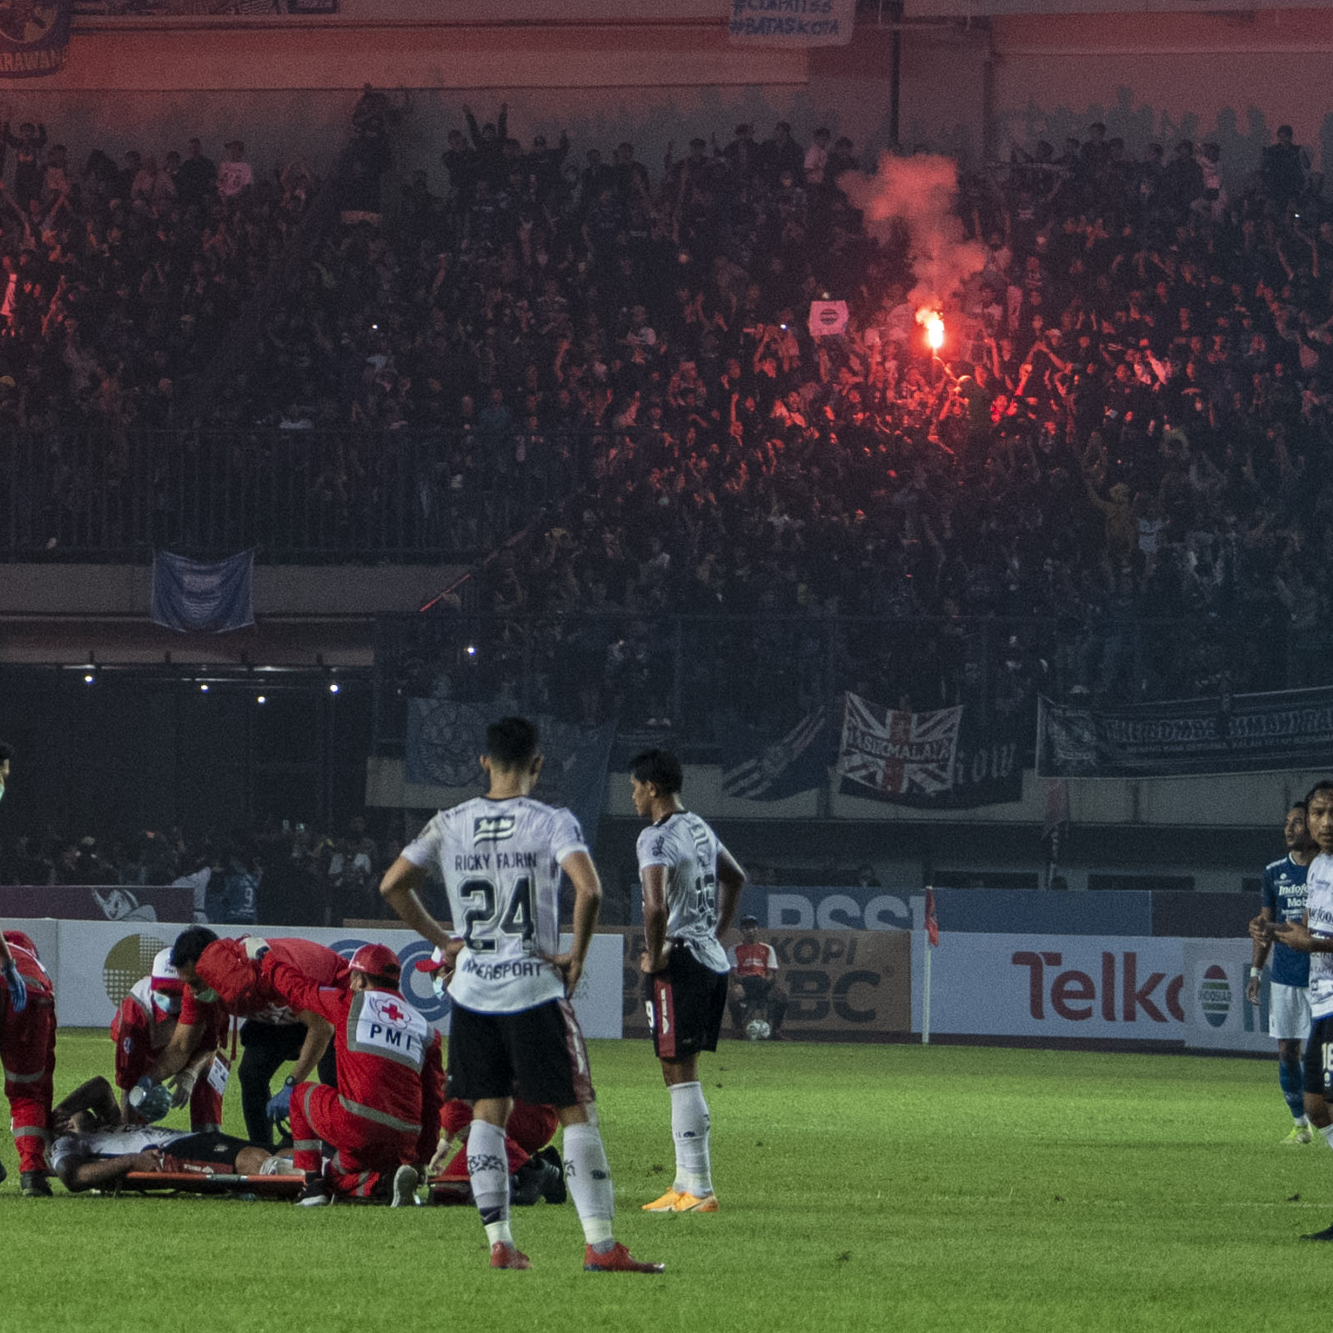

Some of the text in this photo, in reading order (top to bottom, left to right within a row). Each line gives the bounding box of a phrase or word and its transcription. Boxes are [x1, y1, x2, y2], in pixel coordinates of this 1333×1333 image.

[454, 852, 538, 872] RICKY FAJRIN
[459, 877, 535, 952] 24
[771, 936, 859, 966] KOPI
[784, 969, 882, 1024] BC
[369, 1022, 413, 1052] PMI
